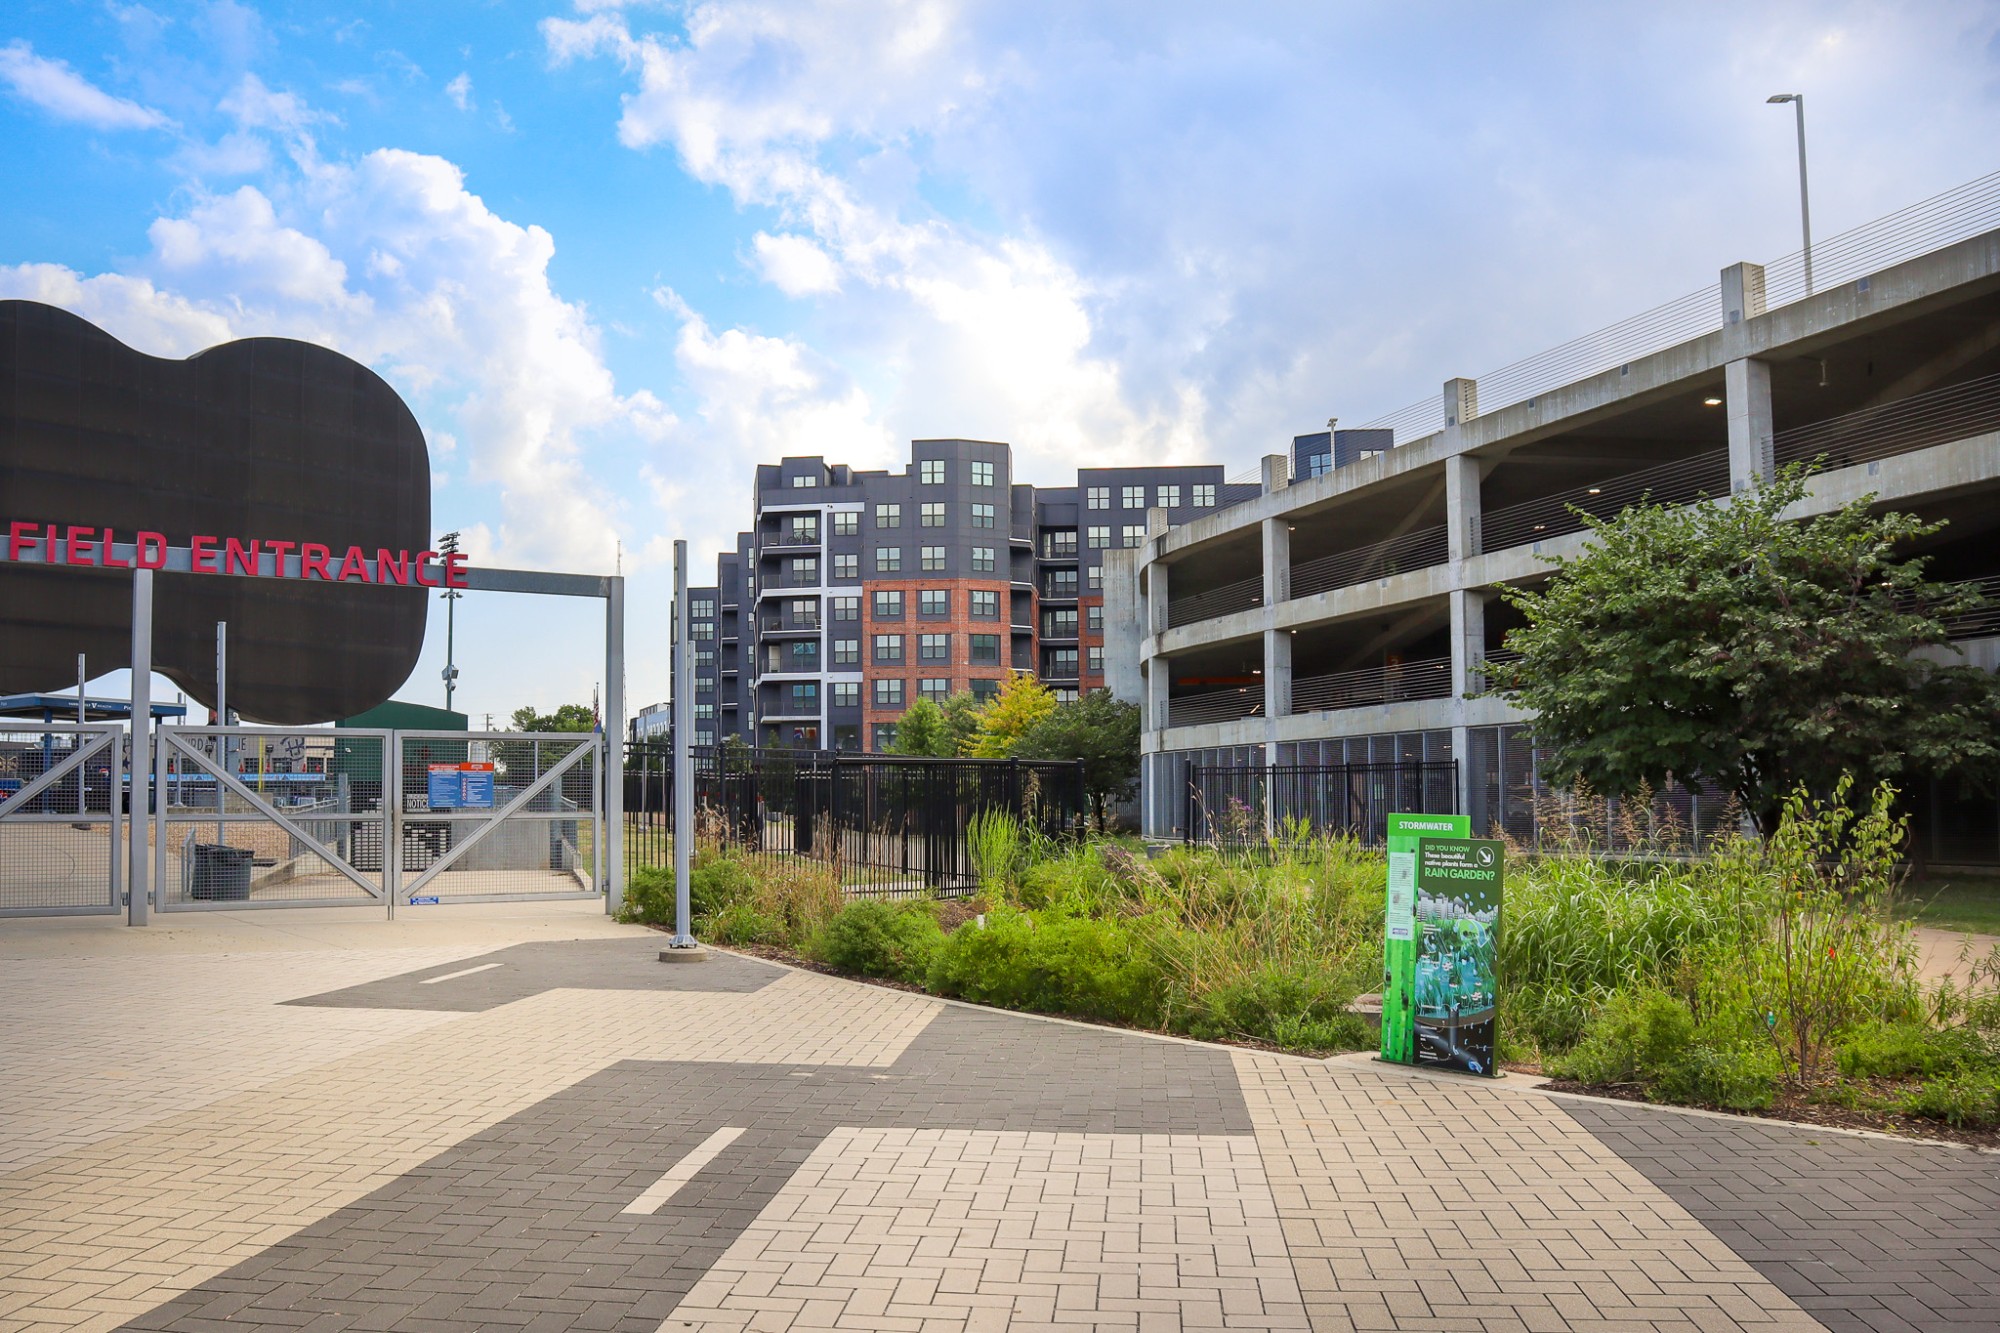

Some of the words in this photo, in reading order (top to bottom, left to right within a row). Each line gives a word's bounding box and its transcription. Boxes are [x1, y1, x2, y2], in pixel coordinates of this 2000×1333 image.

[9, 521, 167, 570] FIELD
[191, 535, 469, 589] ENTRANCE
[1398, 821, 1453, 831] STORMWATER
[1440, 852, 1465, 860] beautiful
[1424, 867, 1448, 878] RAIN
[1450, 868, 1495, 880] GARDEN?
